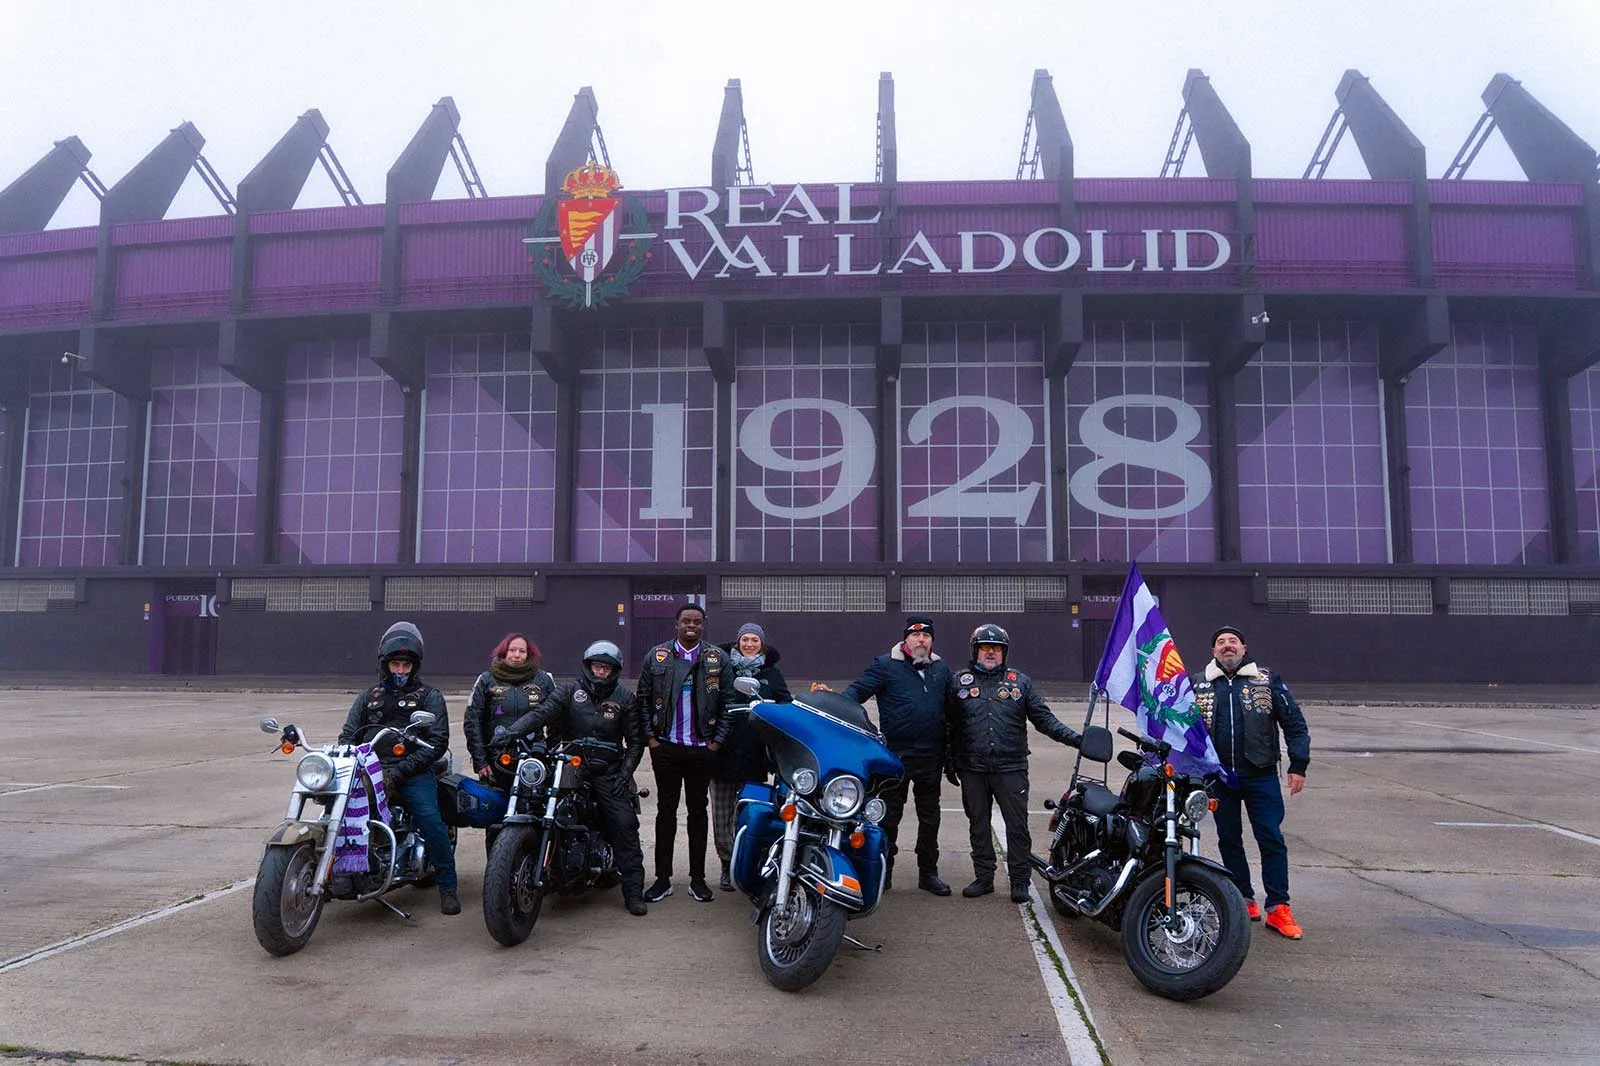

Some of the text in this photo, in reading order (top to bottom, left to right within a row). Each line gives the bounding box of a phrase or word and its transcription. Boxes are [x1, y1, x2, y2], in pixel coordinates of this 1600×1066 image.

[663, 183, 882, 252] REAL
[663, 228, 1232, 280] VALLADOLID
[638, 393, 1213, 526] 1928
[166, 594, 199, 602] PUERTA
